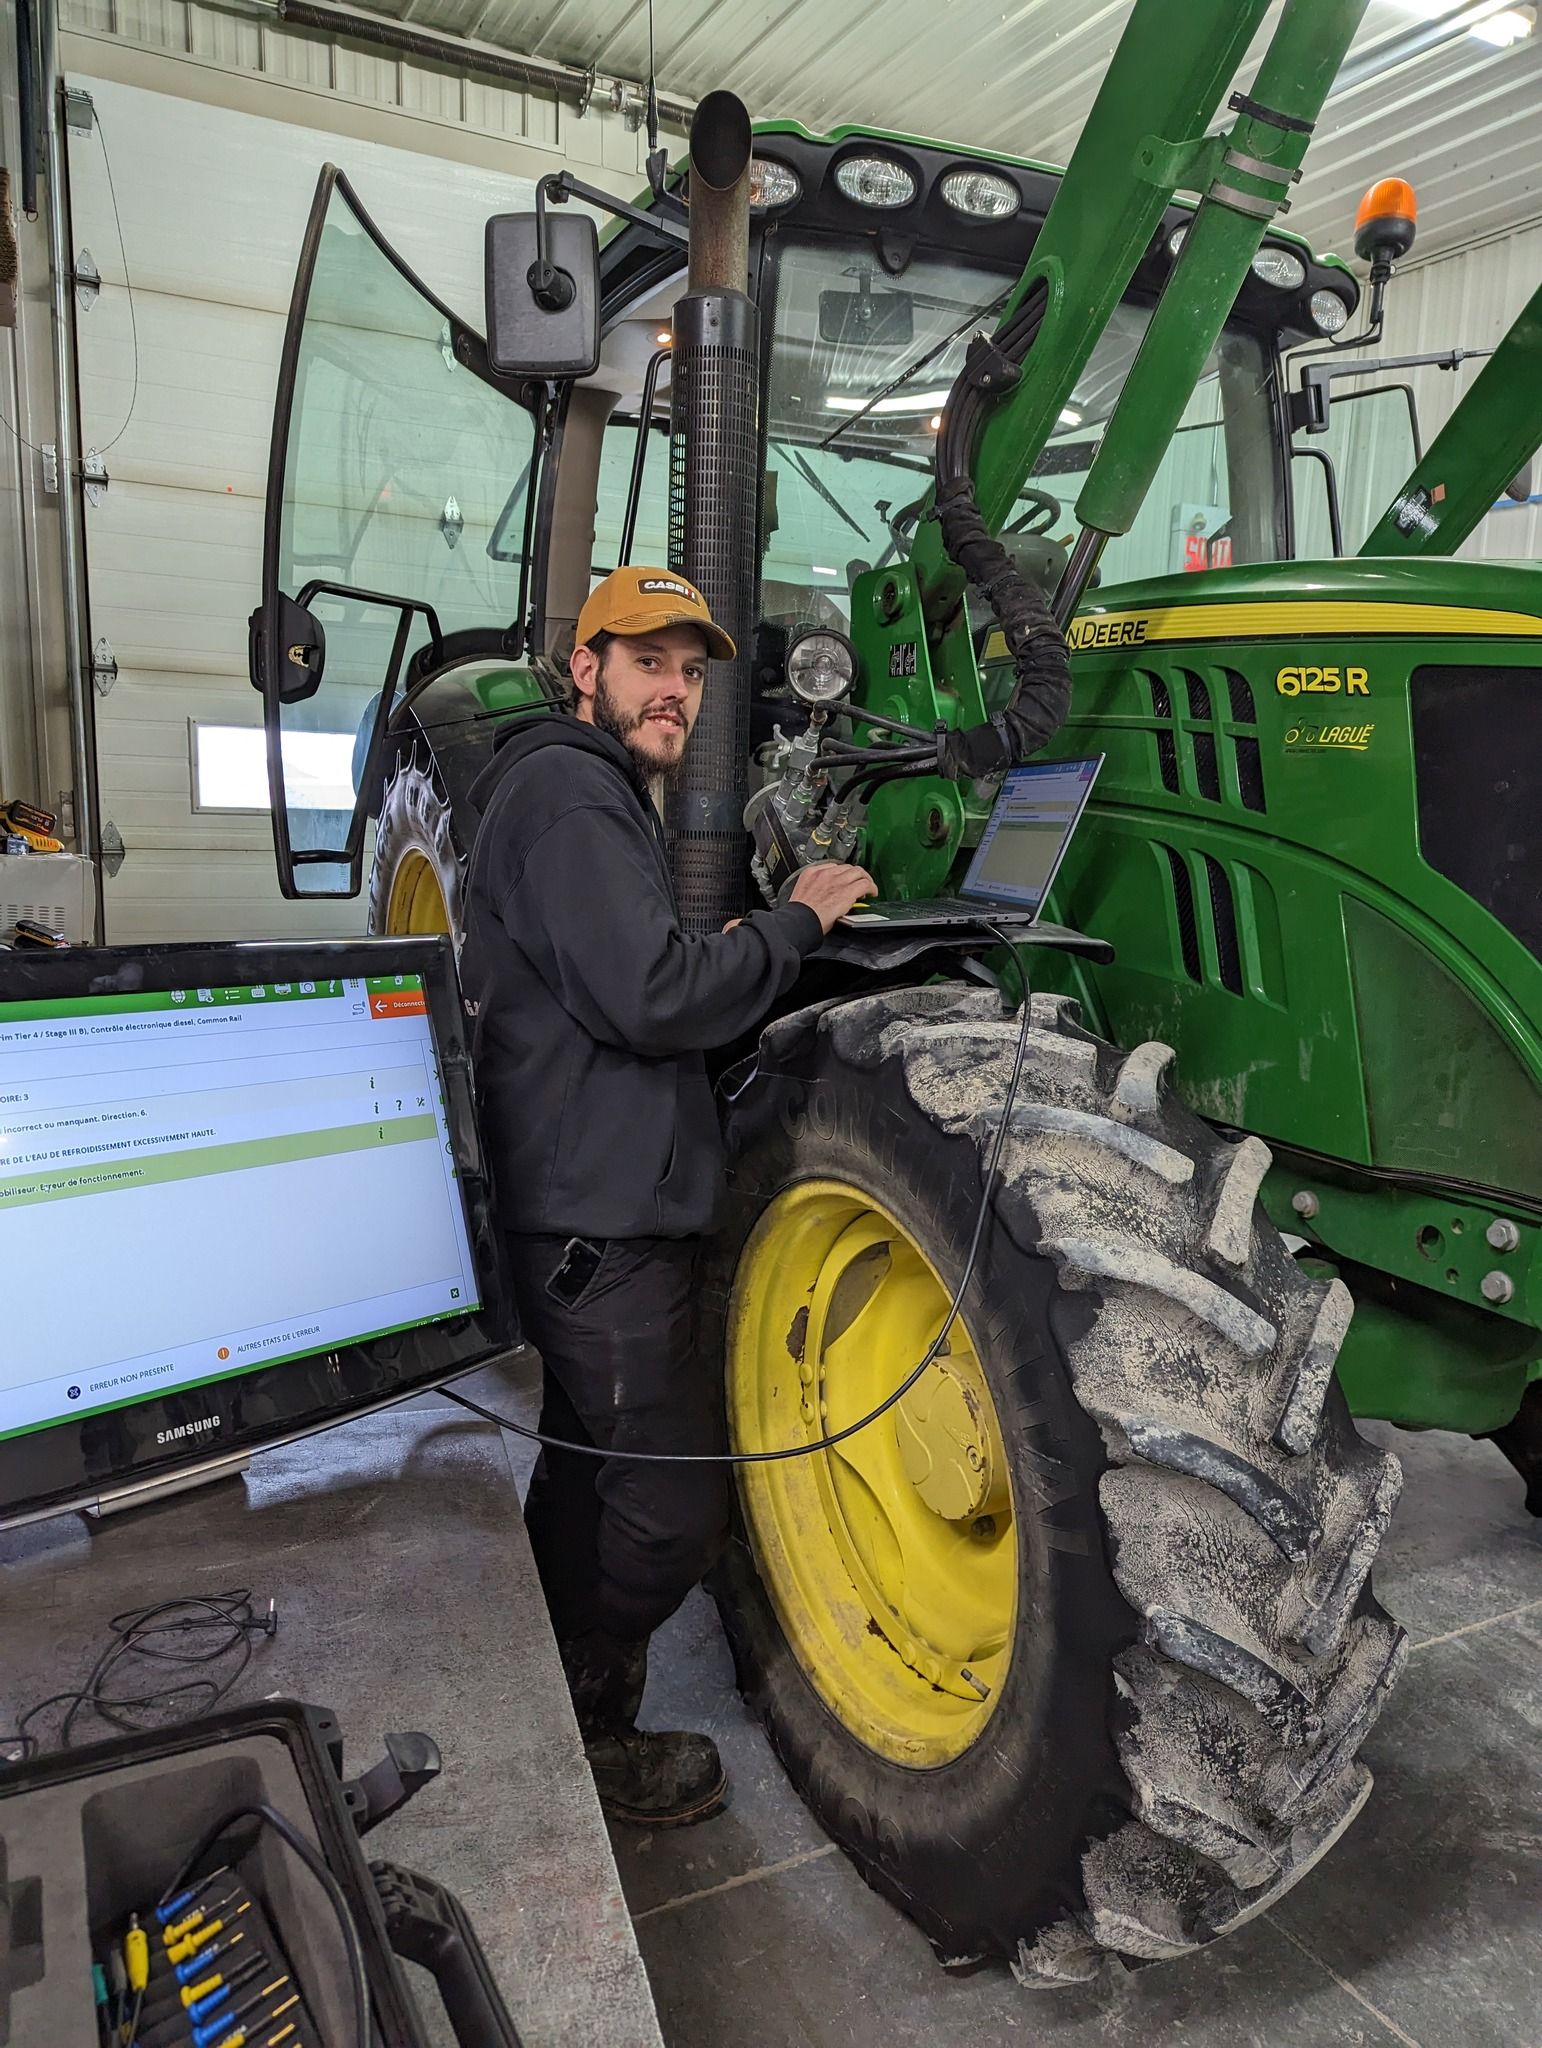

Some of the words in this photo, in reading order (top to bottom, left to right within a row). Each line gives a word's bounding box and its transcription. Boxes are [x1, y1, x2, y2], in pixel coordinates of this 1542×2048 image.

[644, 581, 685, 594] CASE
[1081, 620, 1149, 645] DEERE
[1276, 666, 1341, 697] 6125
[1345, 667, 1371, 697] R
[1319, 724, 1375, 743] LAGUË
[15, 1031, 31, 1040] Tier
[45, 1029, 68, 1039] Stage
[90, 1025, 124, 1034] Contrôle
[125, 1021, 172, 1031] électronique
[197, 1017, 228, 1025] Common
[229, 1014, 242, 1022] Rail
[23, 1093, 29, 1101] 3
[3, 1124, 42, 1134] incorrect
[44, 1121, 55, 1129] ou
[12, 1156, 24, 1164] DE
[49, 1150, 60, 1159] DE
[62, 1140, 132, 1157] REFROIDISSEMENT
[133, 1132, 190, 1147] EXCESSIVEMENT
[67, 1178, 78, 1187] de
[237, 1341, 262, 1353] AUTRES
[262, 1335, 281, 1347] ETATS
[282, 1332, 291, 1341] DE
[89, 1378, 119, 1392] ERREUR
[120, 1373, 139, 1385] NON
[139, 1363, 175, 1378] PRESENTE
[156, 1415, 221, 1444] SAMSUNG
